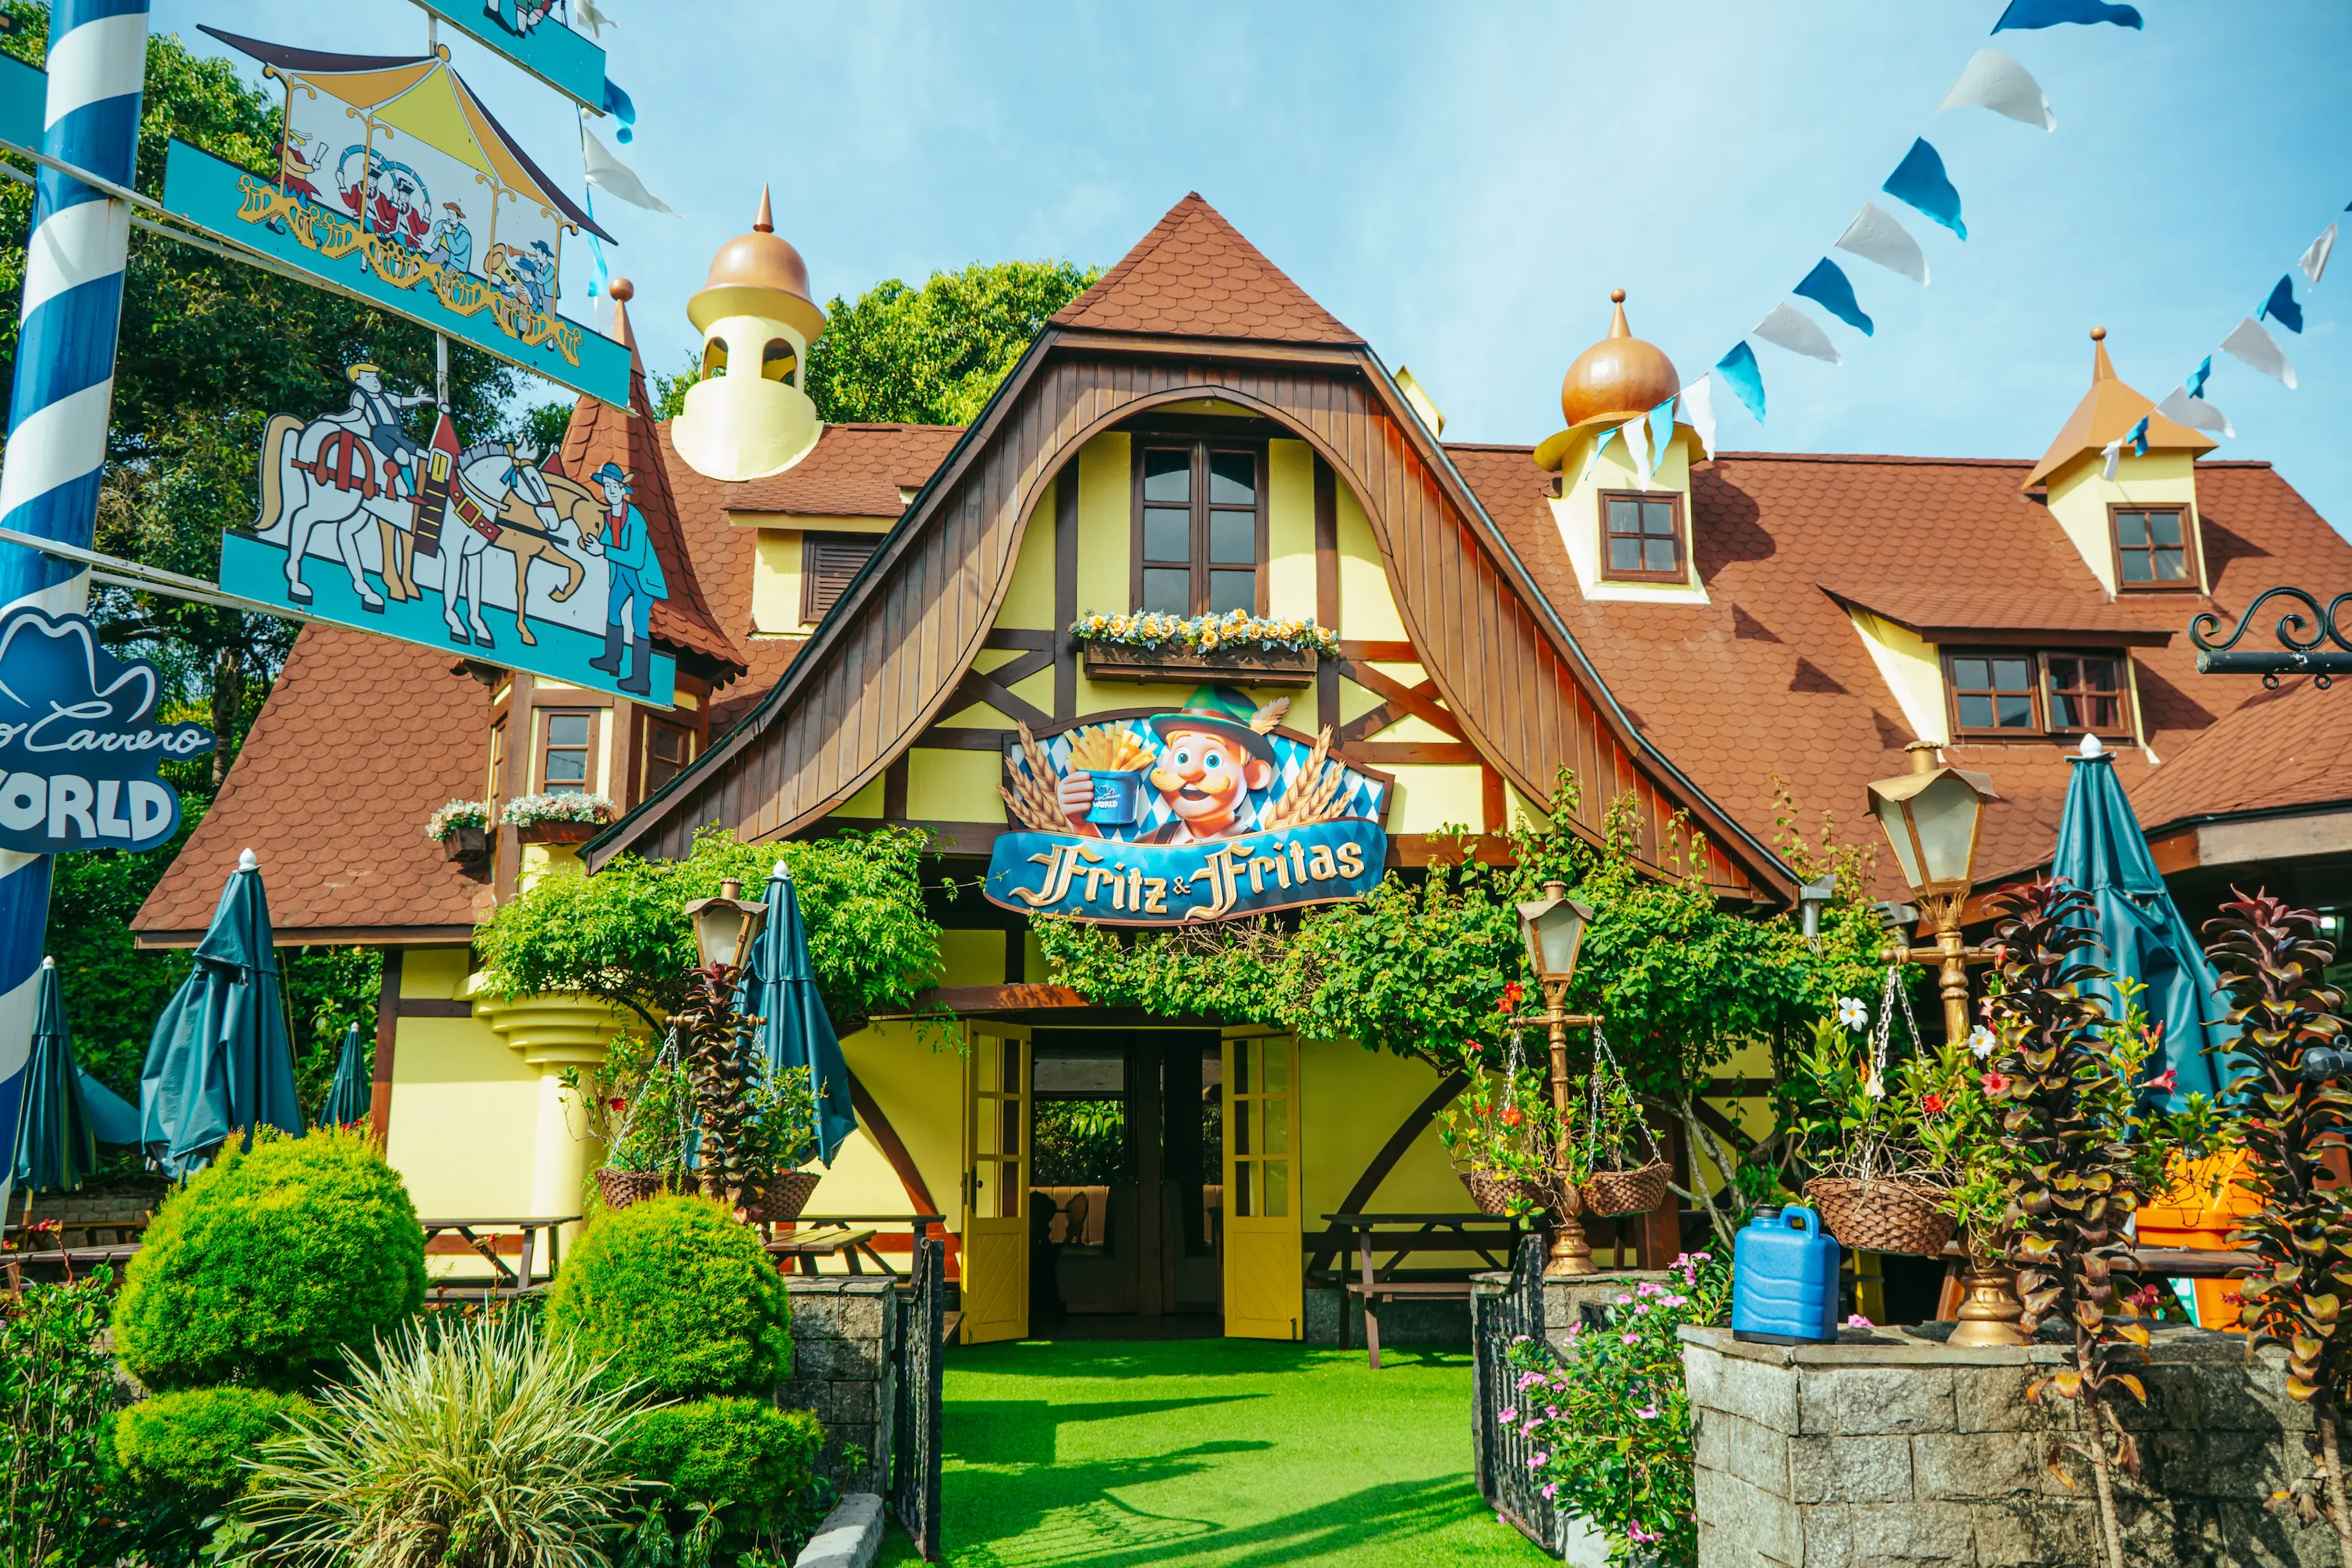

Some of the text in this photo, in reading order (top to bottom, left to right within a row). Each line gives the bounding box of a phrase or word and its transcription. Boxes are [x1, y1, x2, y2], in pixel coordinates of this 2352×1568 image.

[24, 699, 210, 754] Carrero
[0, 768, 172, 841] ORLD
[1093, 800, 1118, 809] WORLD
[1008, 841, 1364, 921] Fritz & Fritas
